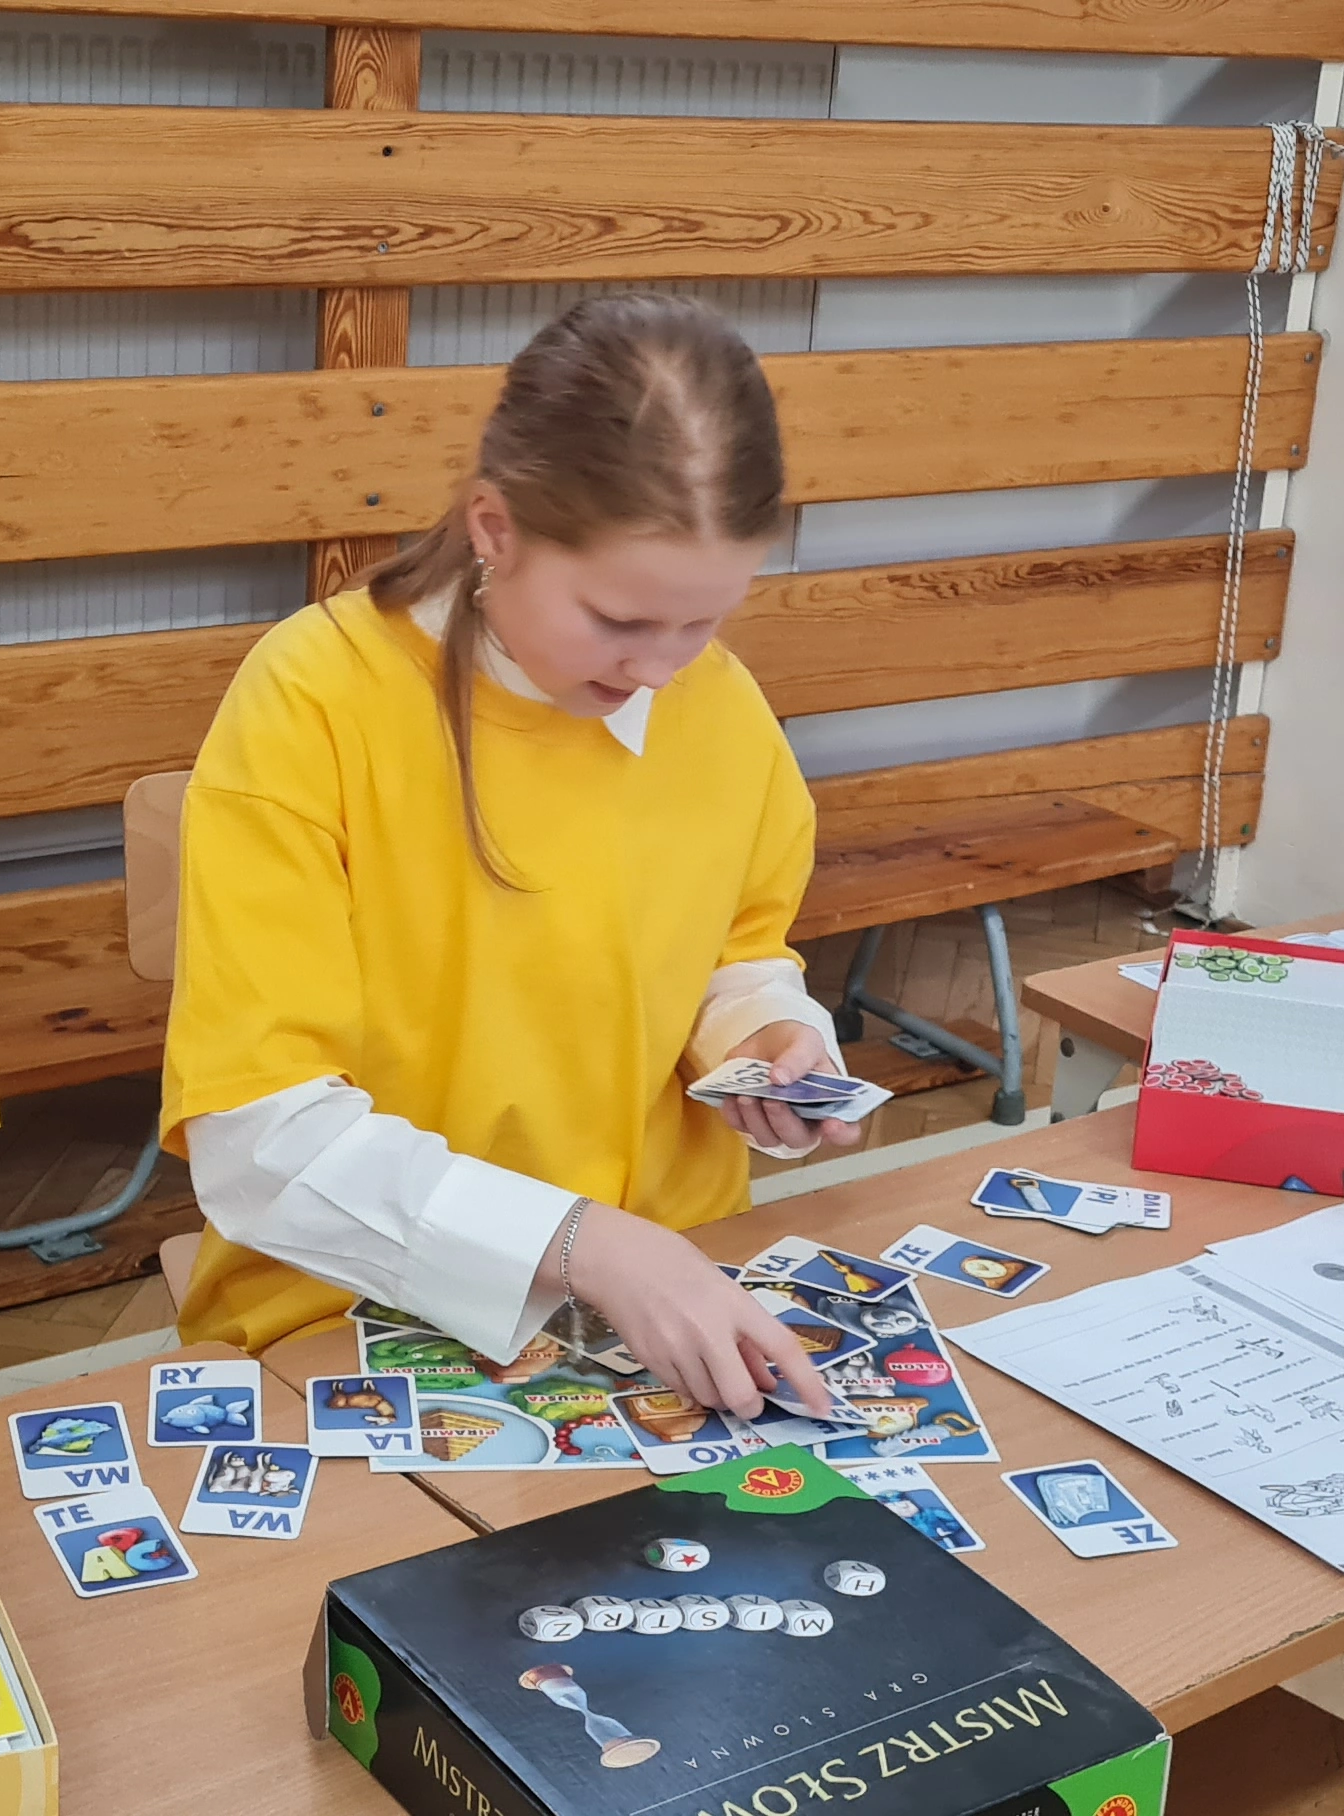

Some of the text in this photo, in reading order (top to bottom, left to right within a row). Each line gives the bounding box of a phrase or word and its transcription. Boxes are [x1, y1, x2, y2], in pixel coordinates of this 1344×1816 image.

[890, 1243, 933, 1266] ZE
[159, 1365, 206, 1386] RY
[382, 1366, 475, 1375] KROKODYL
[891, 1362, 946, 1371] BALON
[834, 1378, 894, 1386] KROWA
[527, 1394, 604, 1403] KAPUSTA
[365, 1432, 413, 1451] LA
[421, 1428, 497, 1437] PIRAMID
[901, 1437, 940, 1445] PIŁA
[687, 1445, 744, 1464] KO
[64, 1465, 131, 1488] MA
[744, 1470, 802, 1496] ALEXANDER
[747, 1469, 780, 1488] A
[43, 1502, 95, 1529] TE
[228, 1508, 293, 1534] WA
[1112, 1523, 1168, 1546] ZE
[683, 1671, 929, 1770] GRA SŁOWNA
[857, 1678, 1069, 1779] MISTRZ
